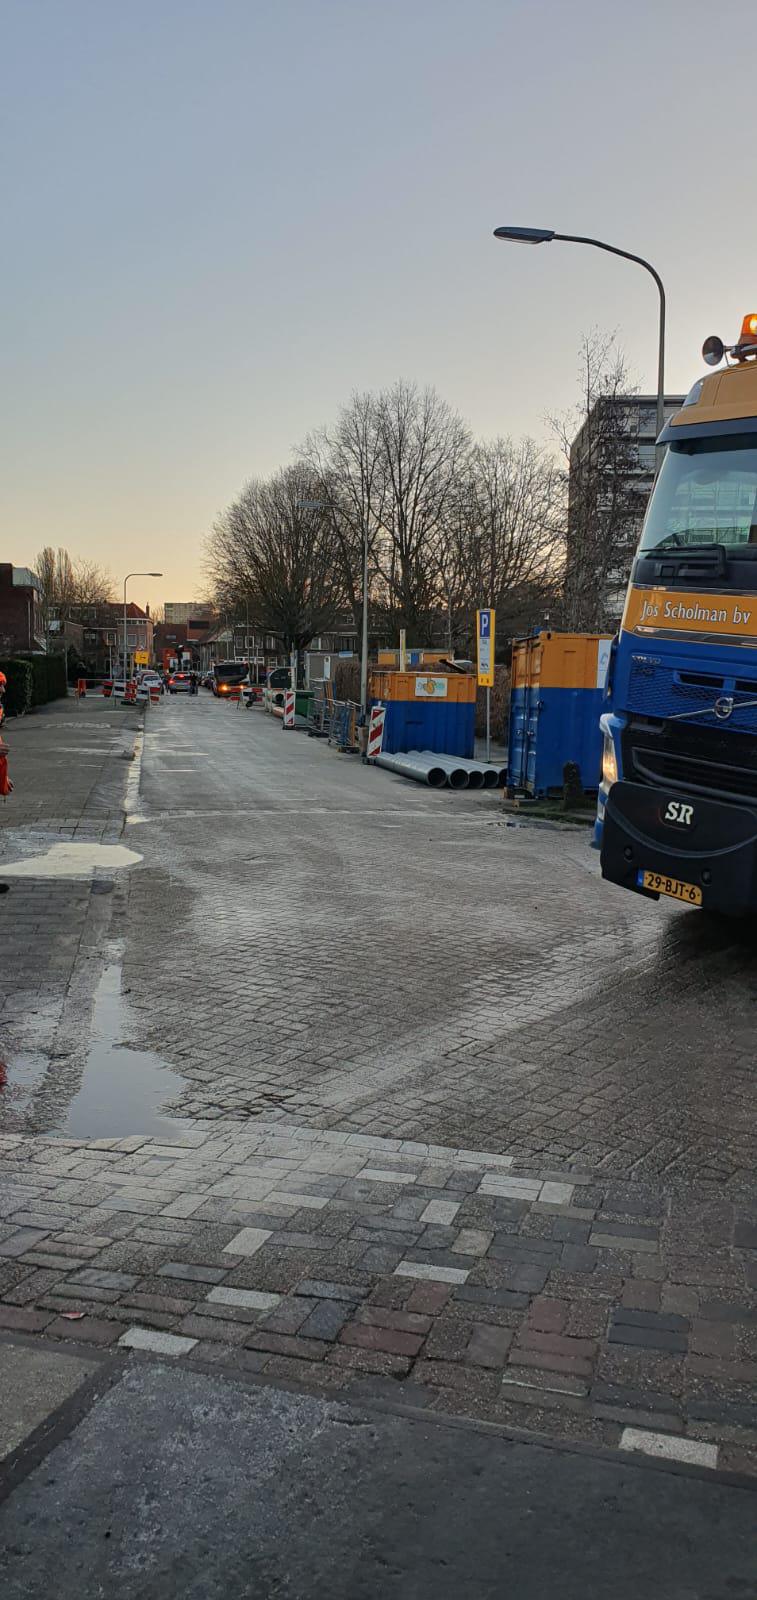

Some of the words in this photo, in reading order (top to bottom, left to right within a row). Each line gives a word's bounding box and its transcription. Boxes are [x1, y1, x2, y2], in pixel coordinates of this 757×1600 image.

[640, 600, 658, 621] Jos
[664, 601, 727, 622] Scholman
[733, 606, 751, 624] bv
[481, 614, 489, 636] P
[664, 801, 694, 825] SR
[647, 873, 696, 900] 29-BJT-6
